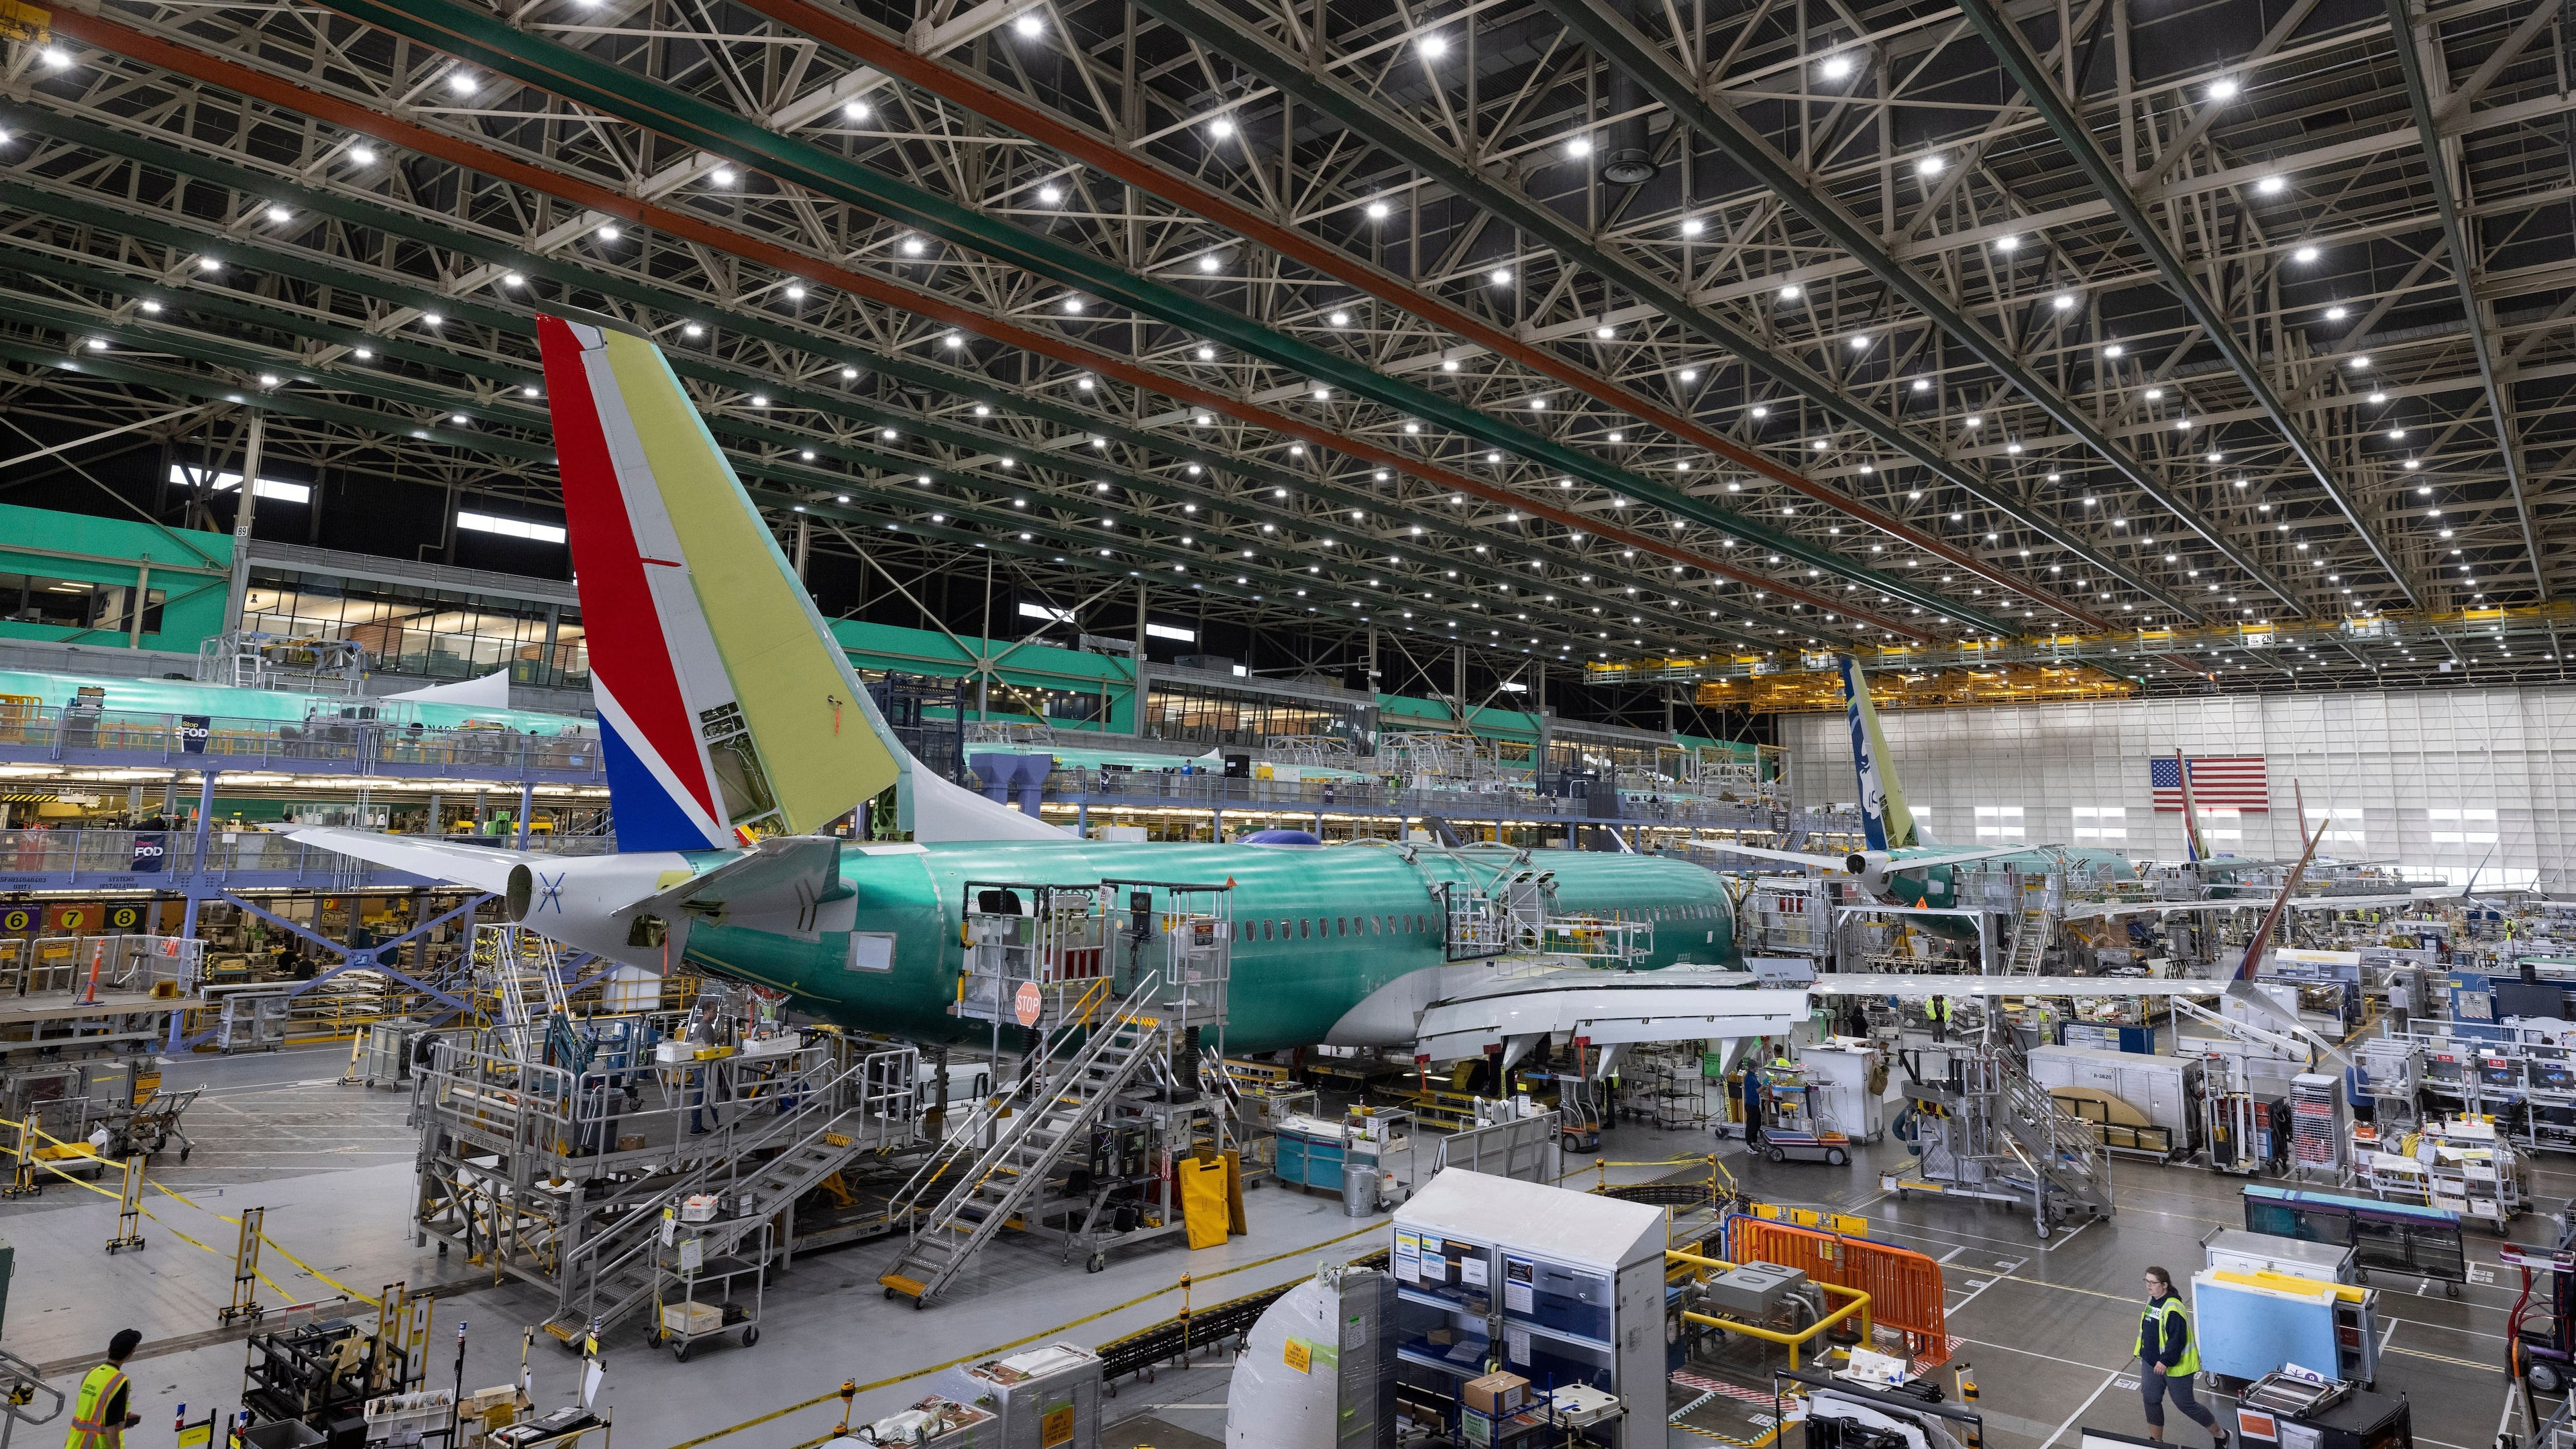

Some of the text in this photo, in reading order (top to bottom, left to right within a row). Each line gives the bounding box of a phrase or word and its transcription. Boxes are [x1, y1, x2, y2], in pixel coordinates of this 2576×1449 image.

[238, 527, 246, 535] B9
[2262, 634, 2271, 642] 2N
[182, 728, 208, 737] FOD
[135, 847, 163, 857] FOD
[10, 914, 23, 927] 6
[67, 912, 78, 925] 7
[119, 911, 130, 924] 8
[1647, 921, 1652, 932] 19
[1017, 995, 1039, 1013] STOP
[1053, 1414, 1063, 1422] SWA
